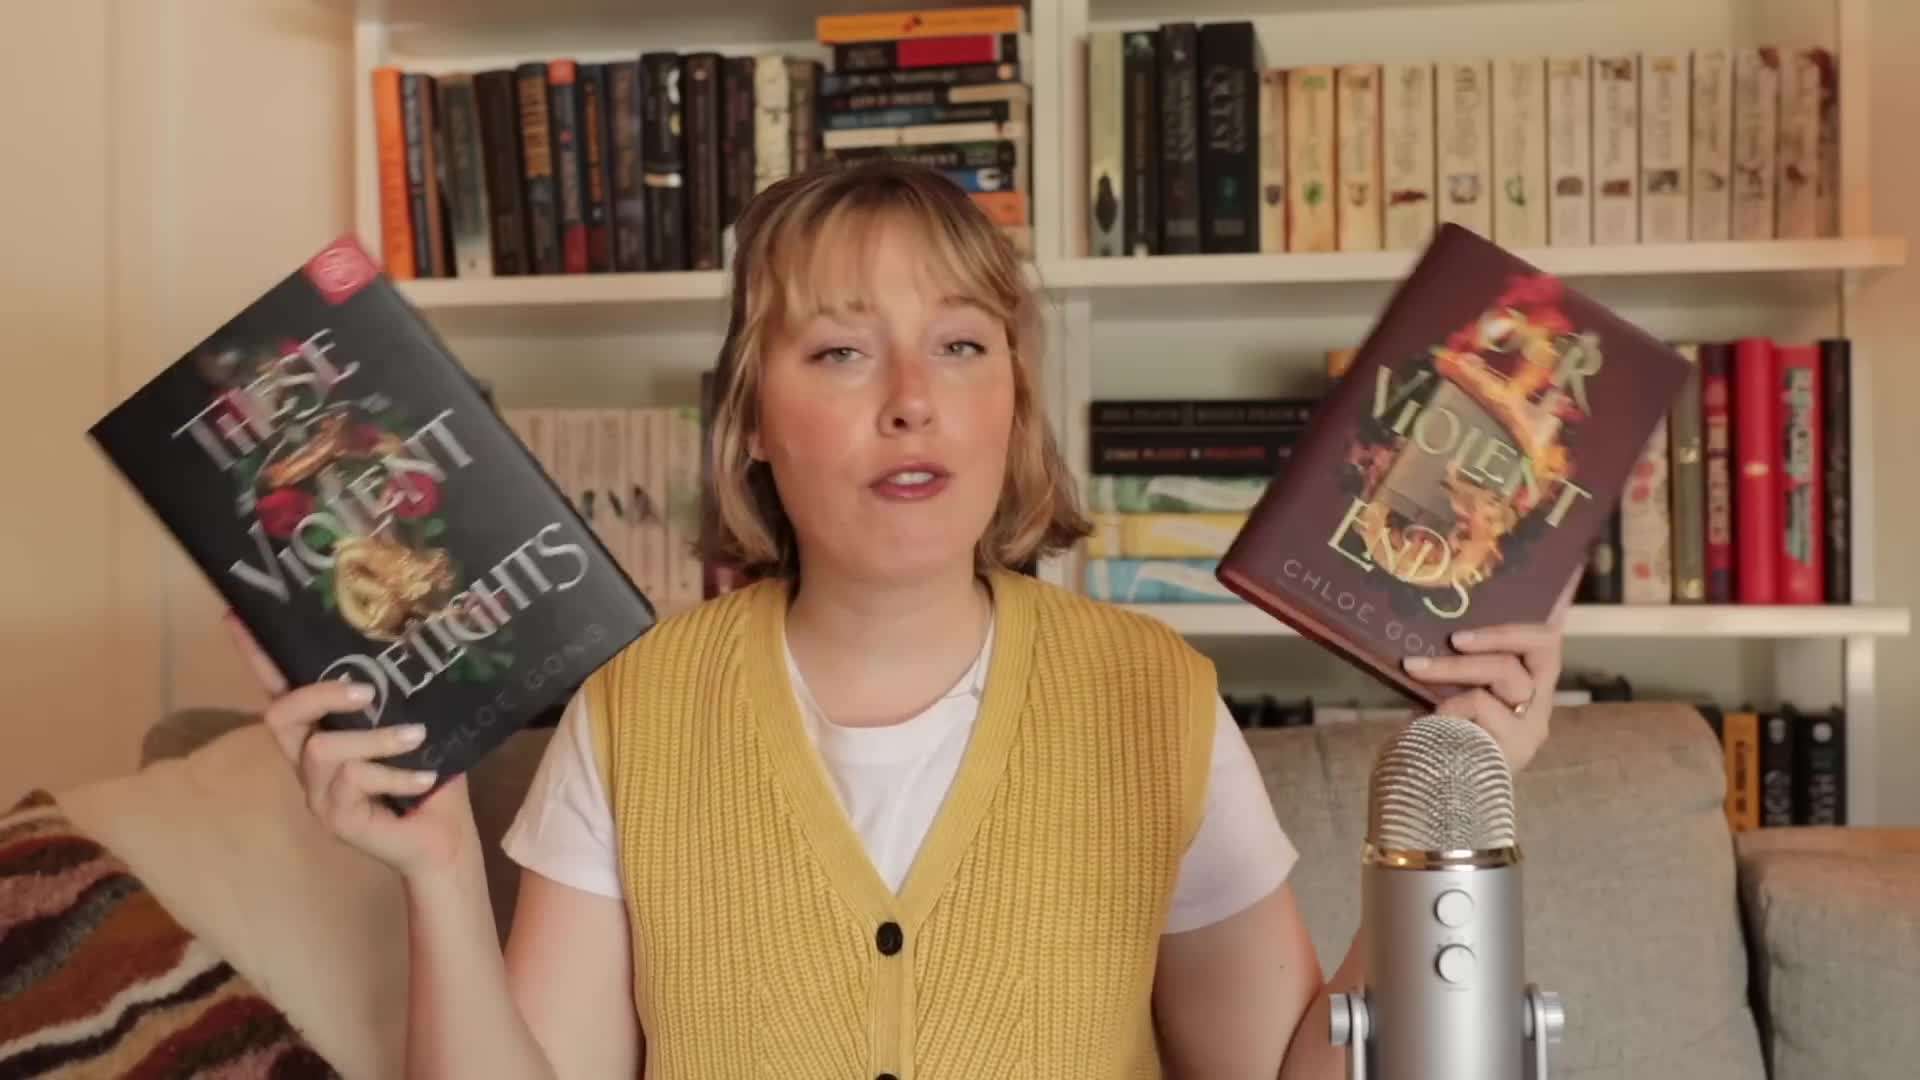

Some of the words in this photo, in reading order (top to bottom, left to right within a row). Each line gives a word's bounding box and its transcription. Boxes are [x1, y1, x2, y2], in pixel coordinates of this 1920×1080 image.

[171, 327, 361, 473] THESE
[1372, 365, 1593, 529] VIOLENT
[228, 407, 474, 604] VIOLENT
[1327, 496, 1483, 619] ENDS
[316, 521, 590, 726] DELIGHTS
[1283, 558, 1376, 625] CHLOE
[1385, 620, 1438, 657] GON
[421, 690, 519, 769] CHLOE
